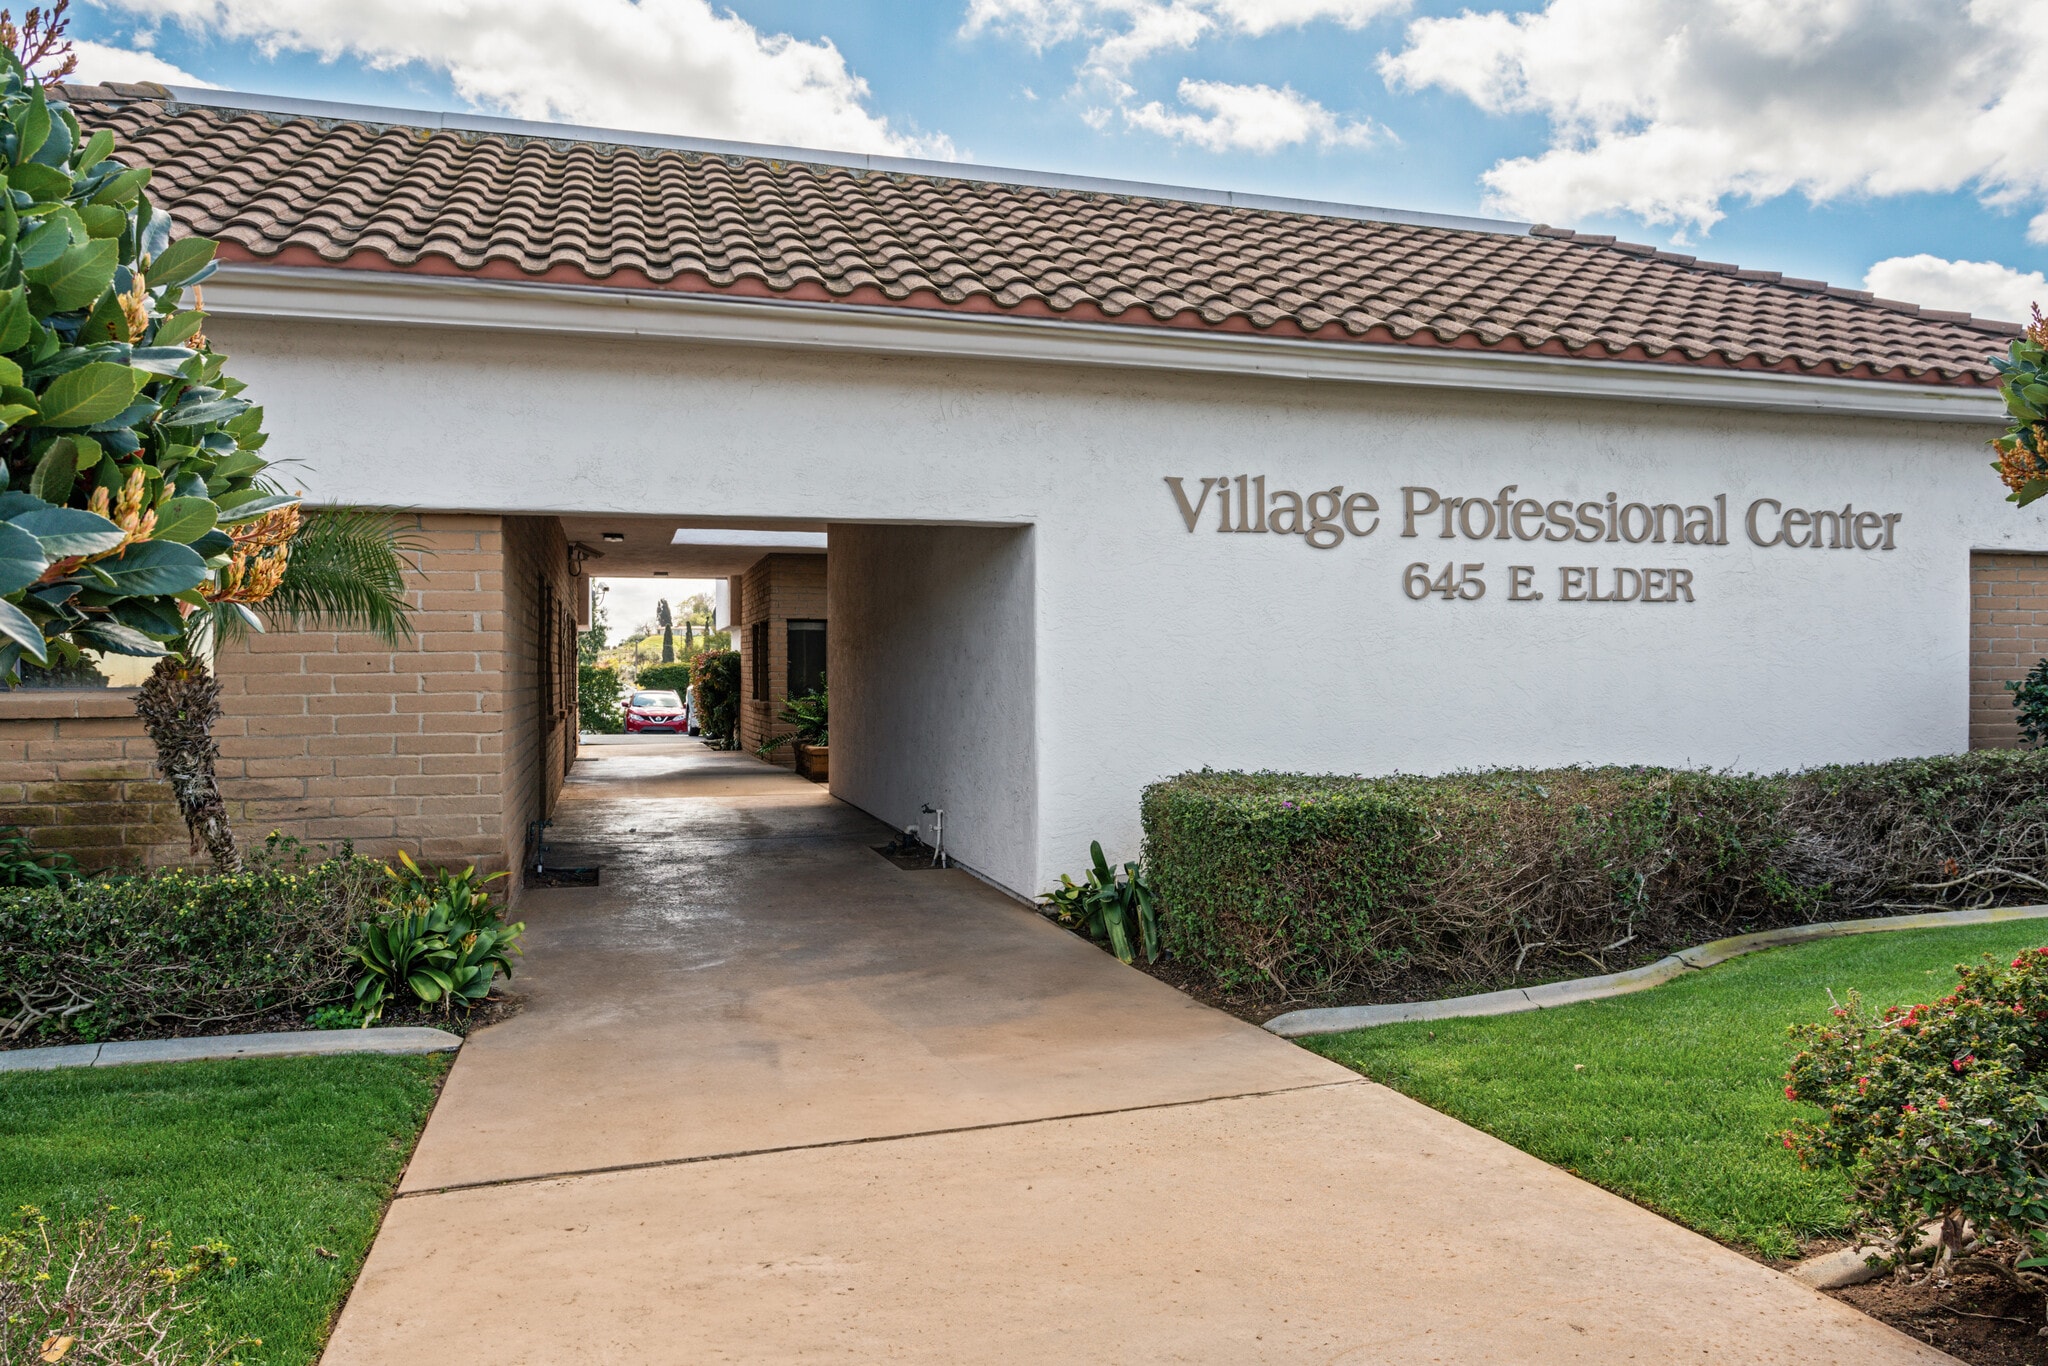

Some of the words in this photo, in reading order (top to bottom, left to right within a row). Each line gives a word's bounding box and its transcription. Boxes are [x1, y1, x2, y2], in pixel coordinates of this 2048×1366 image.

[1164, 474, 1380, 548] Village
[1401, 485, 1729, 545] Professional
[1745, 498, 1902, 551] Center
[1403, 561, 1486, 600] 645
[1507, 565, 1544, 602] E.
[1558, 566, 1695, 602] ELDER
